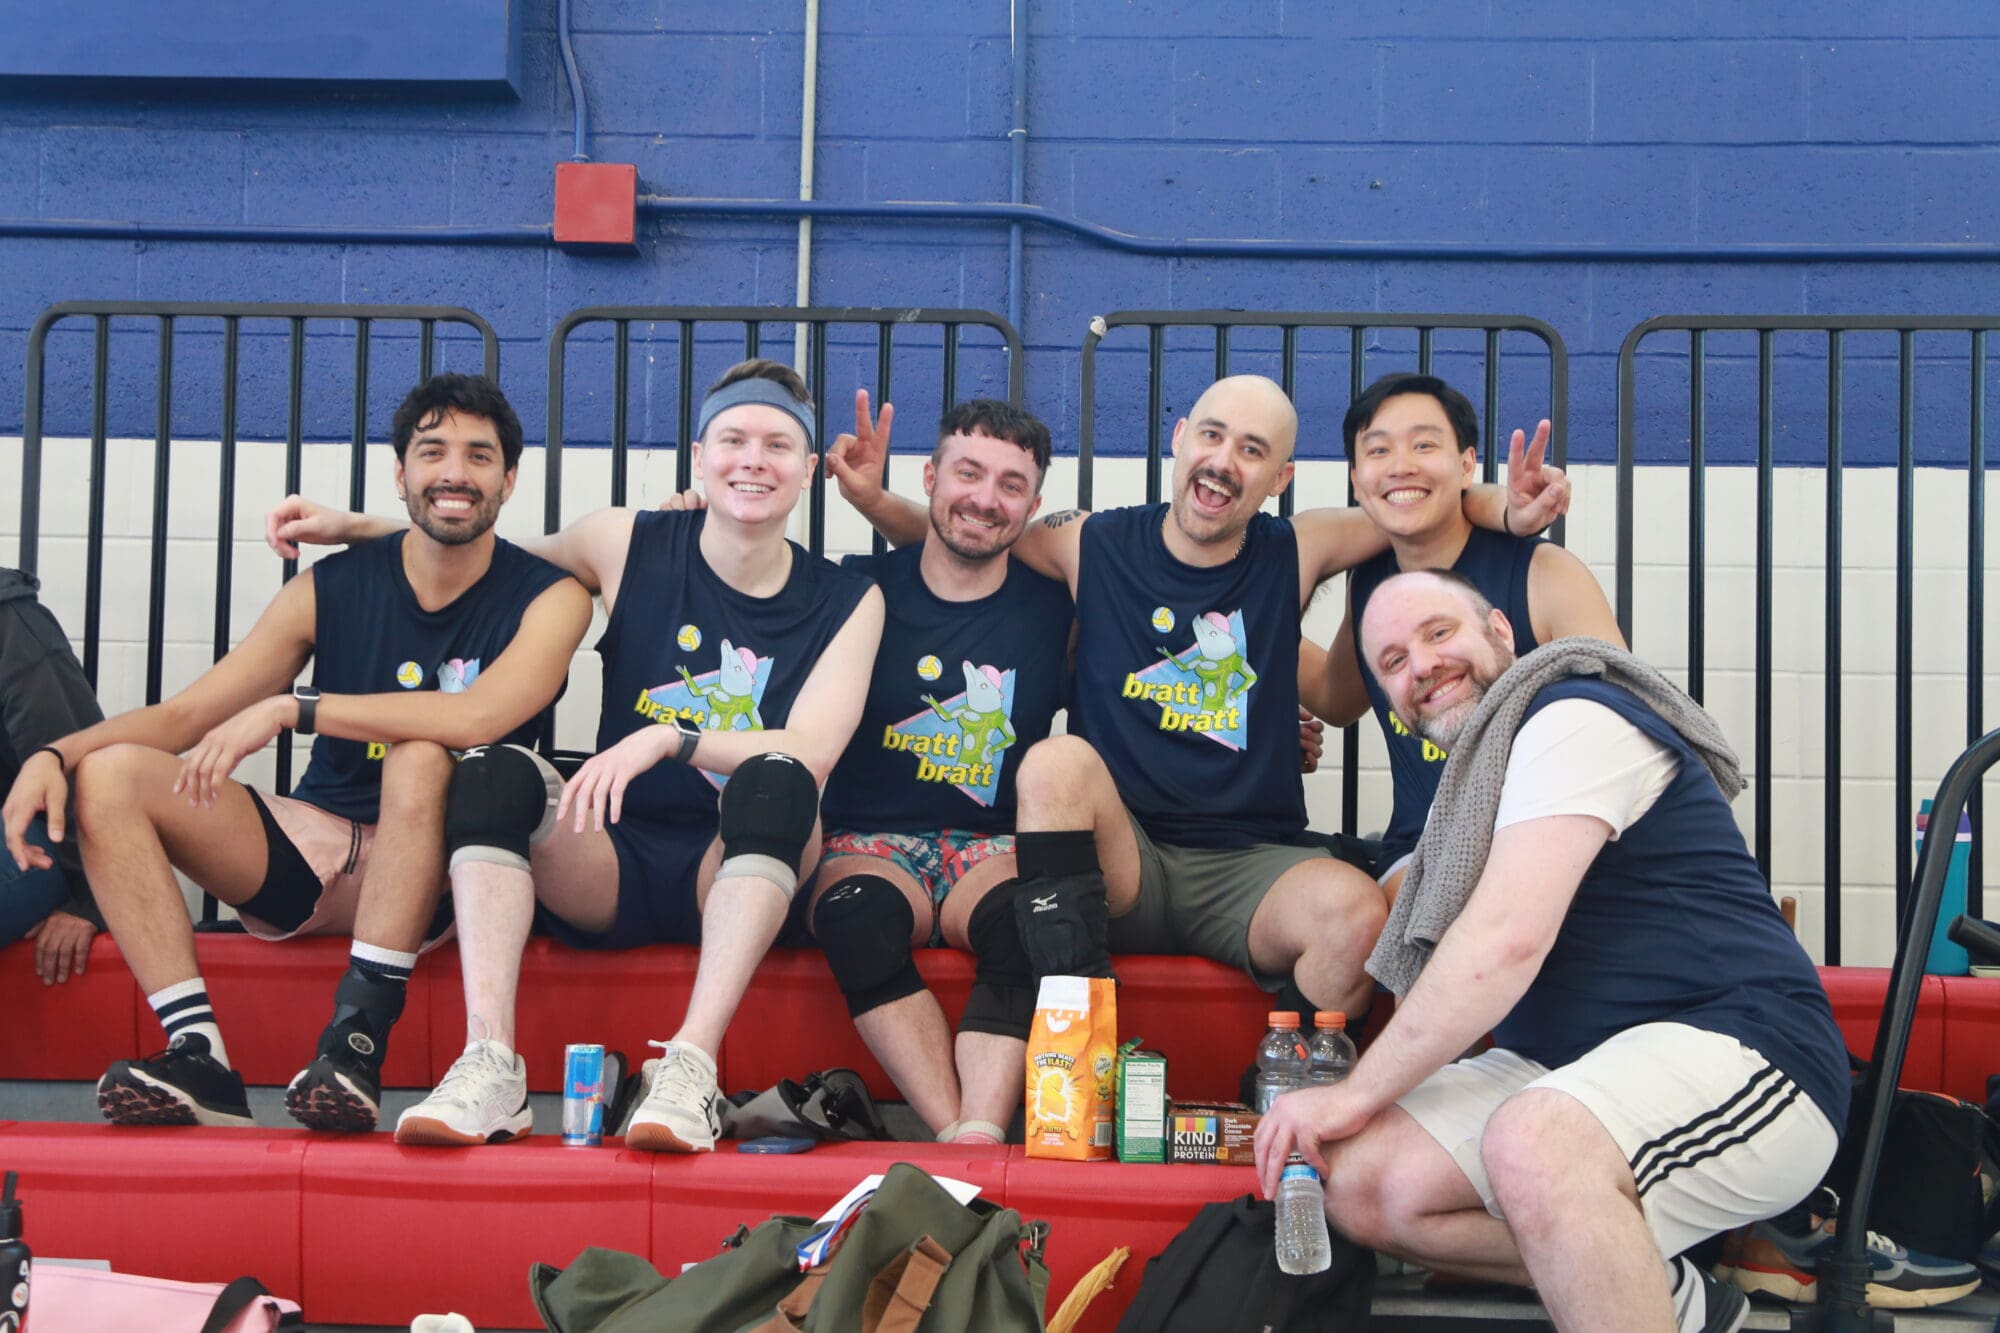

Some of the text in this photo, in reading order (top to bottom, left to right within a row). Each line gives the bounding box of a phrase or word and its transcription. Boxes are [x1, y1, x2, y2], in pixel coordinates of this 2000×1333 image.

[1122, 672, 1201, 706] bratt
[634, 688, 705, 725] bratt
[1159, 705, 1240, 733] bratt
[883, 725, 959, 757] bratt
[916, 756, 995, 787] bratt
[1047, 1058, 1073, 1071] BLAST!
[1174, 1131, 1216, 1146] KIND
[1174, 1151, 1215, 1160] PROTEIN
